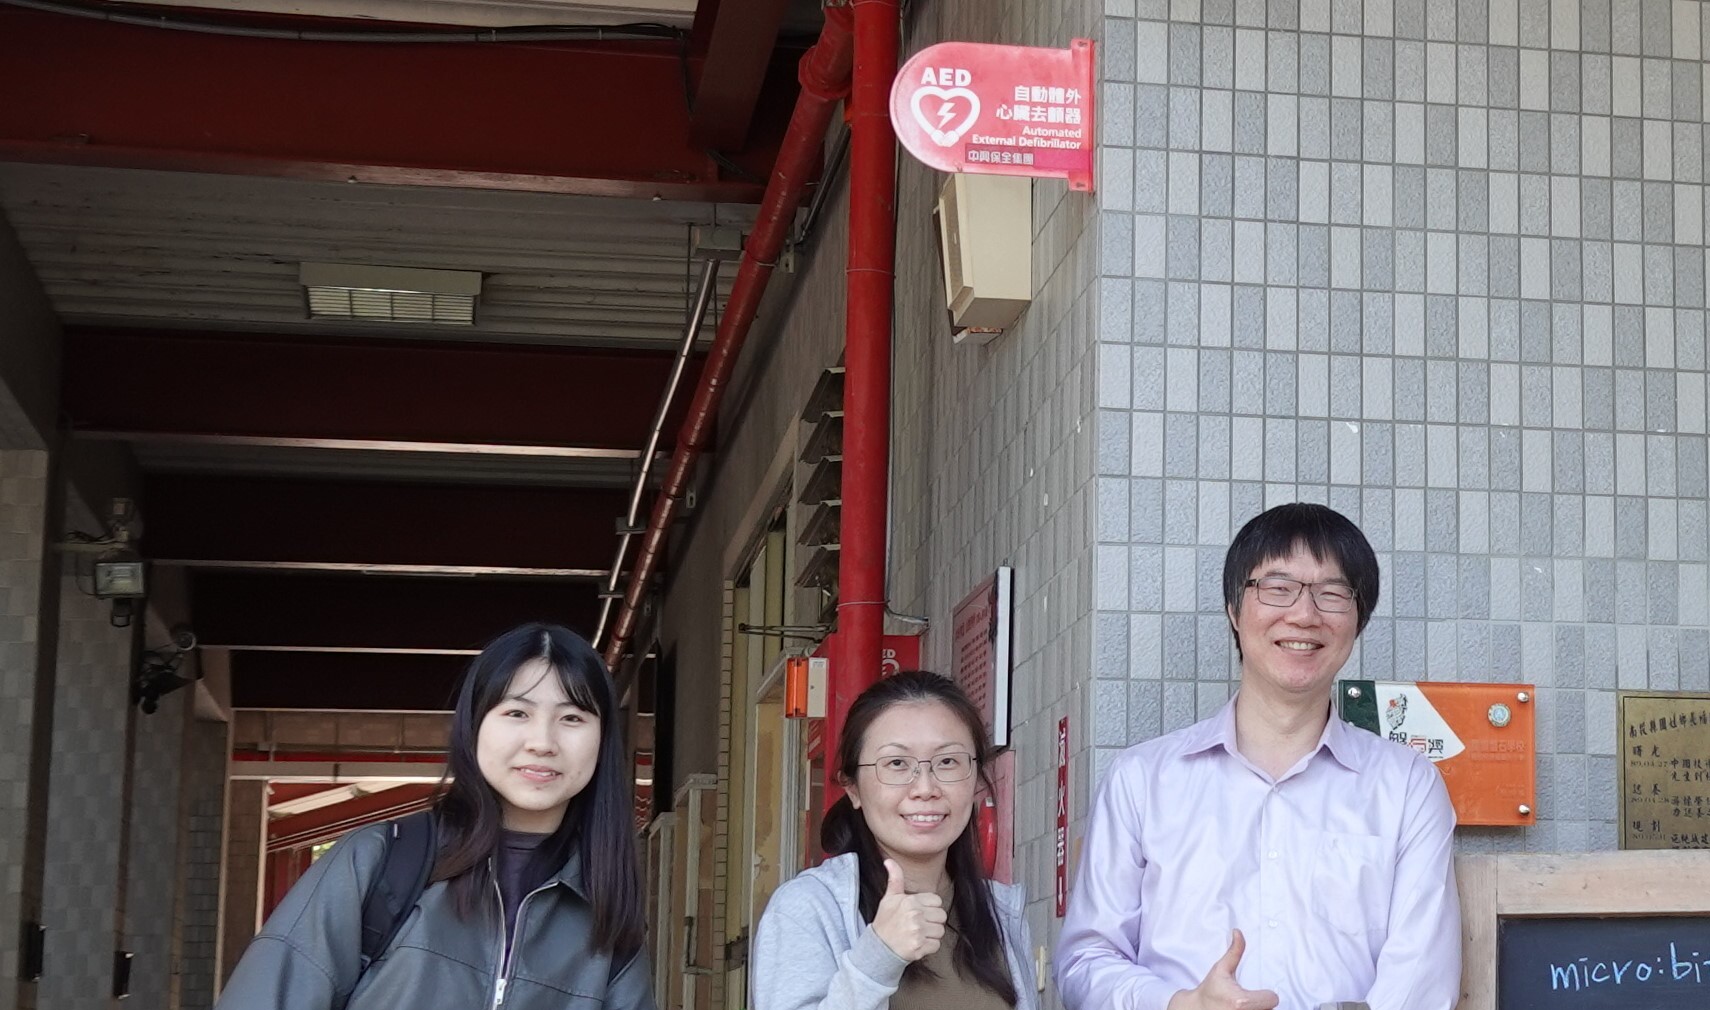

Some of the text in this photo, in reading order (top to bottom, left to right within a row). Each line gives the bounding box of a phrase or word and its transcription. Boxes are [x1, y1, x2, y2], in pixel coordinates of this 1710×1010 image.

[921, 67, 972, 87] AED
[1014, 85, 1081, 105] 自動體外
[996, 104, 1081, 124] 心臟去顫器
[1022, 126, 1081, 139] Automated
[972, 134, 1081, 150] External Defibrillator
[968, 151, 1034, 166] 中興保全集團
